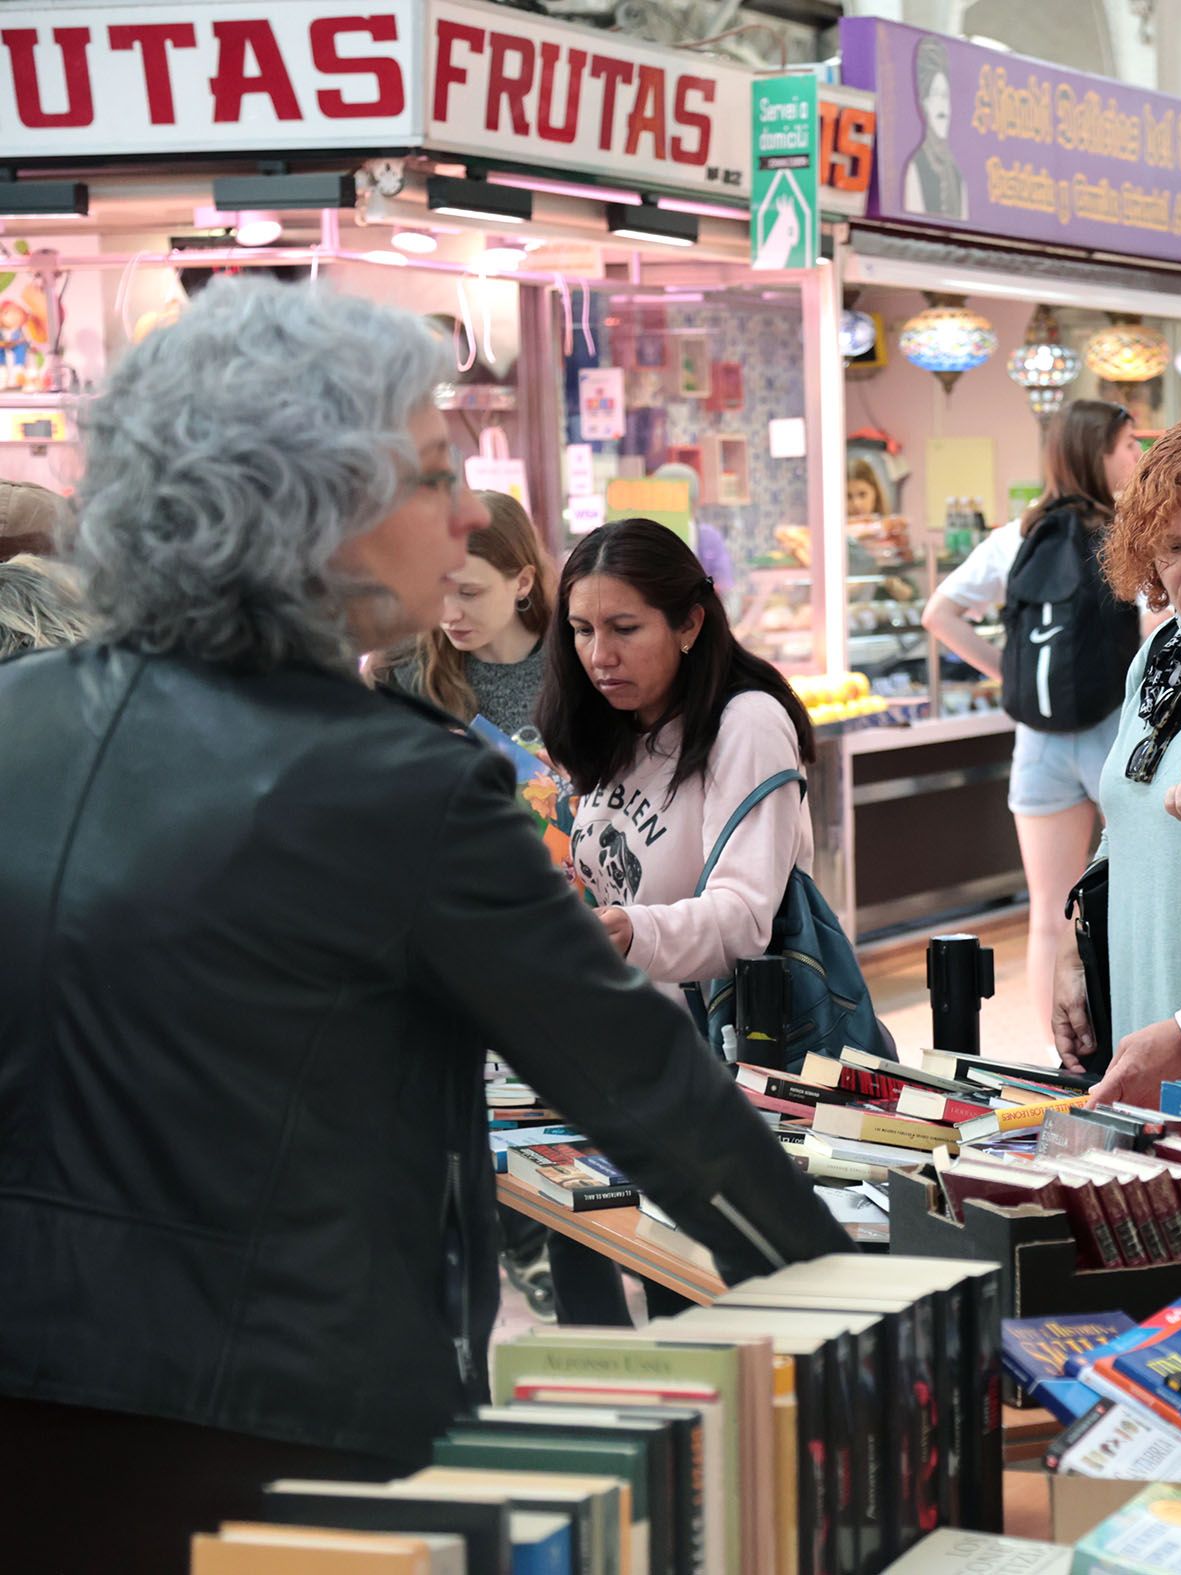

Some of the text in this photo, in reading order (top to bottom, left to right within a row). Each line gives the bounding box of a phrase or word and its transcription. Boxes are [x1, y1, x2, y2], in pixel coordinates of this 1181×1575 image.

[433, 19, 717, 167] FRUTAS
[759, 96, 798, 122] Servei
[759, 124, 809, 151] domicili
[607, 784, 667, 847] BEEN
[1001, 1109, 1027, 1121] LEONES
